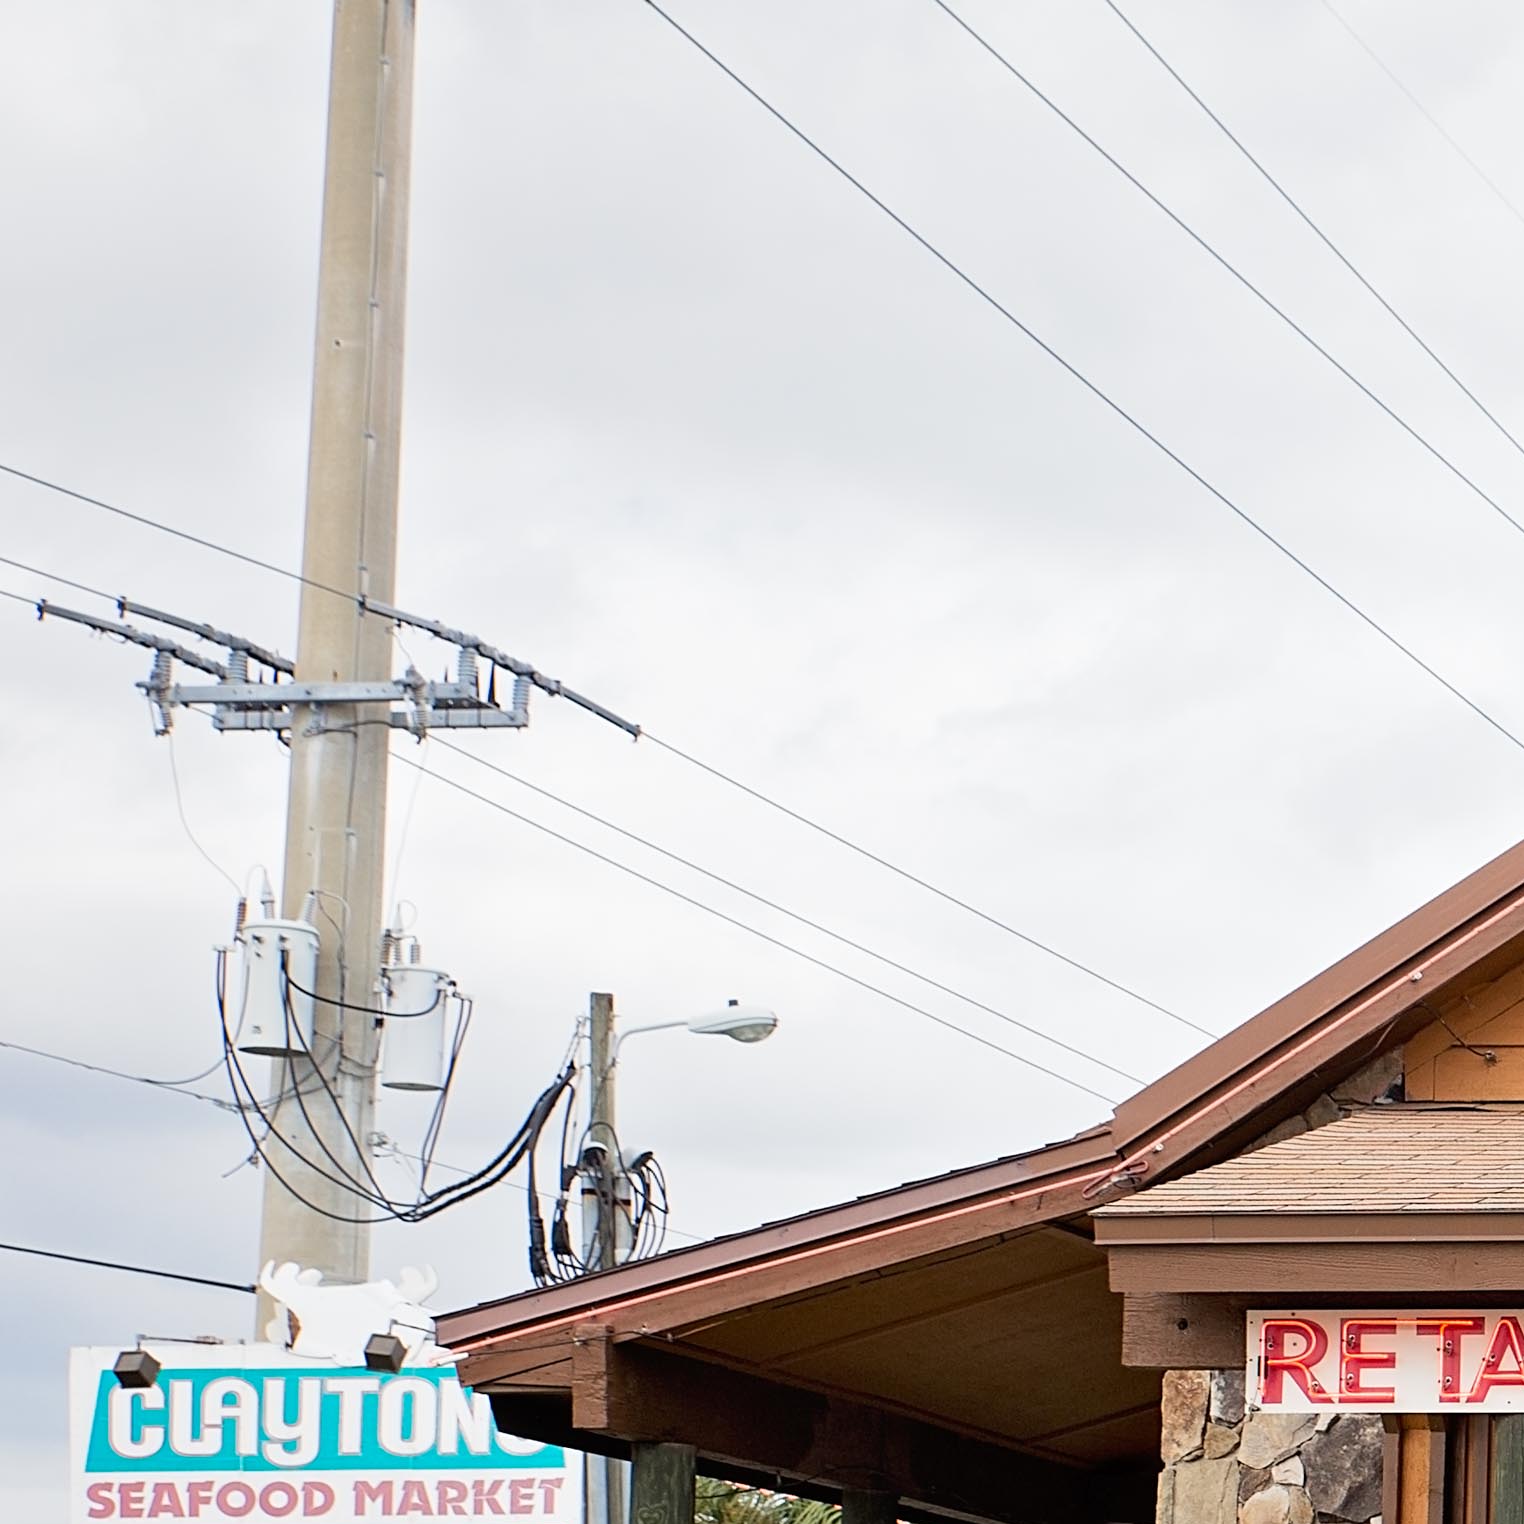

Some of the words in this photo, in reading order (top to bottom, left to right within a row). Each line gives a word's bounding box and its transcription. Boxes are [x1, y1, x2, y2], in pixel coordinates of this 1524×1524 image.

[107, 1375, 550, 1468] CLAYTON
[86, 1481, 335, 1519] SEAFOOD
[353, 1478, 565, 1516] MARKET
